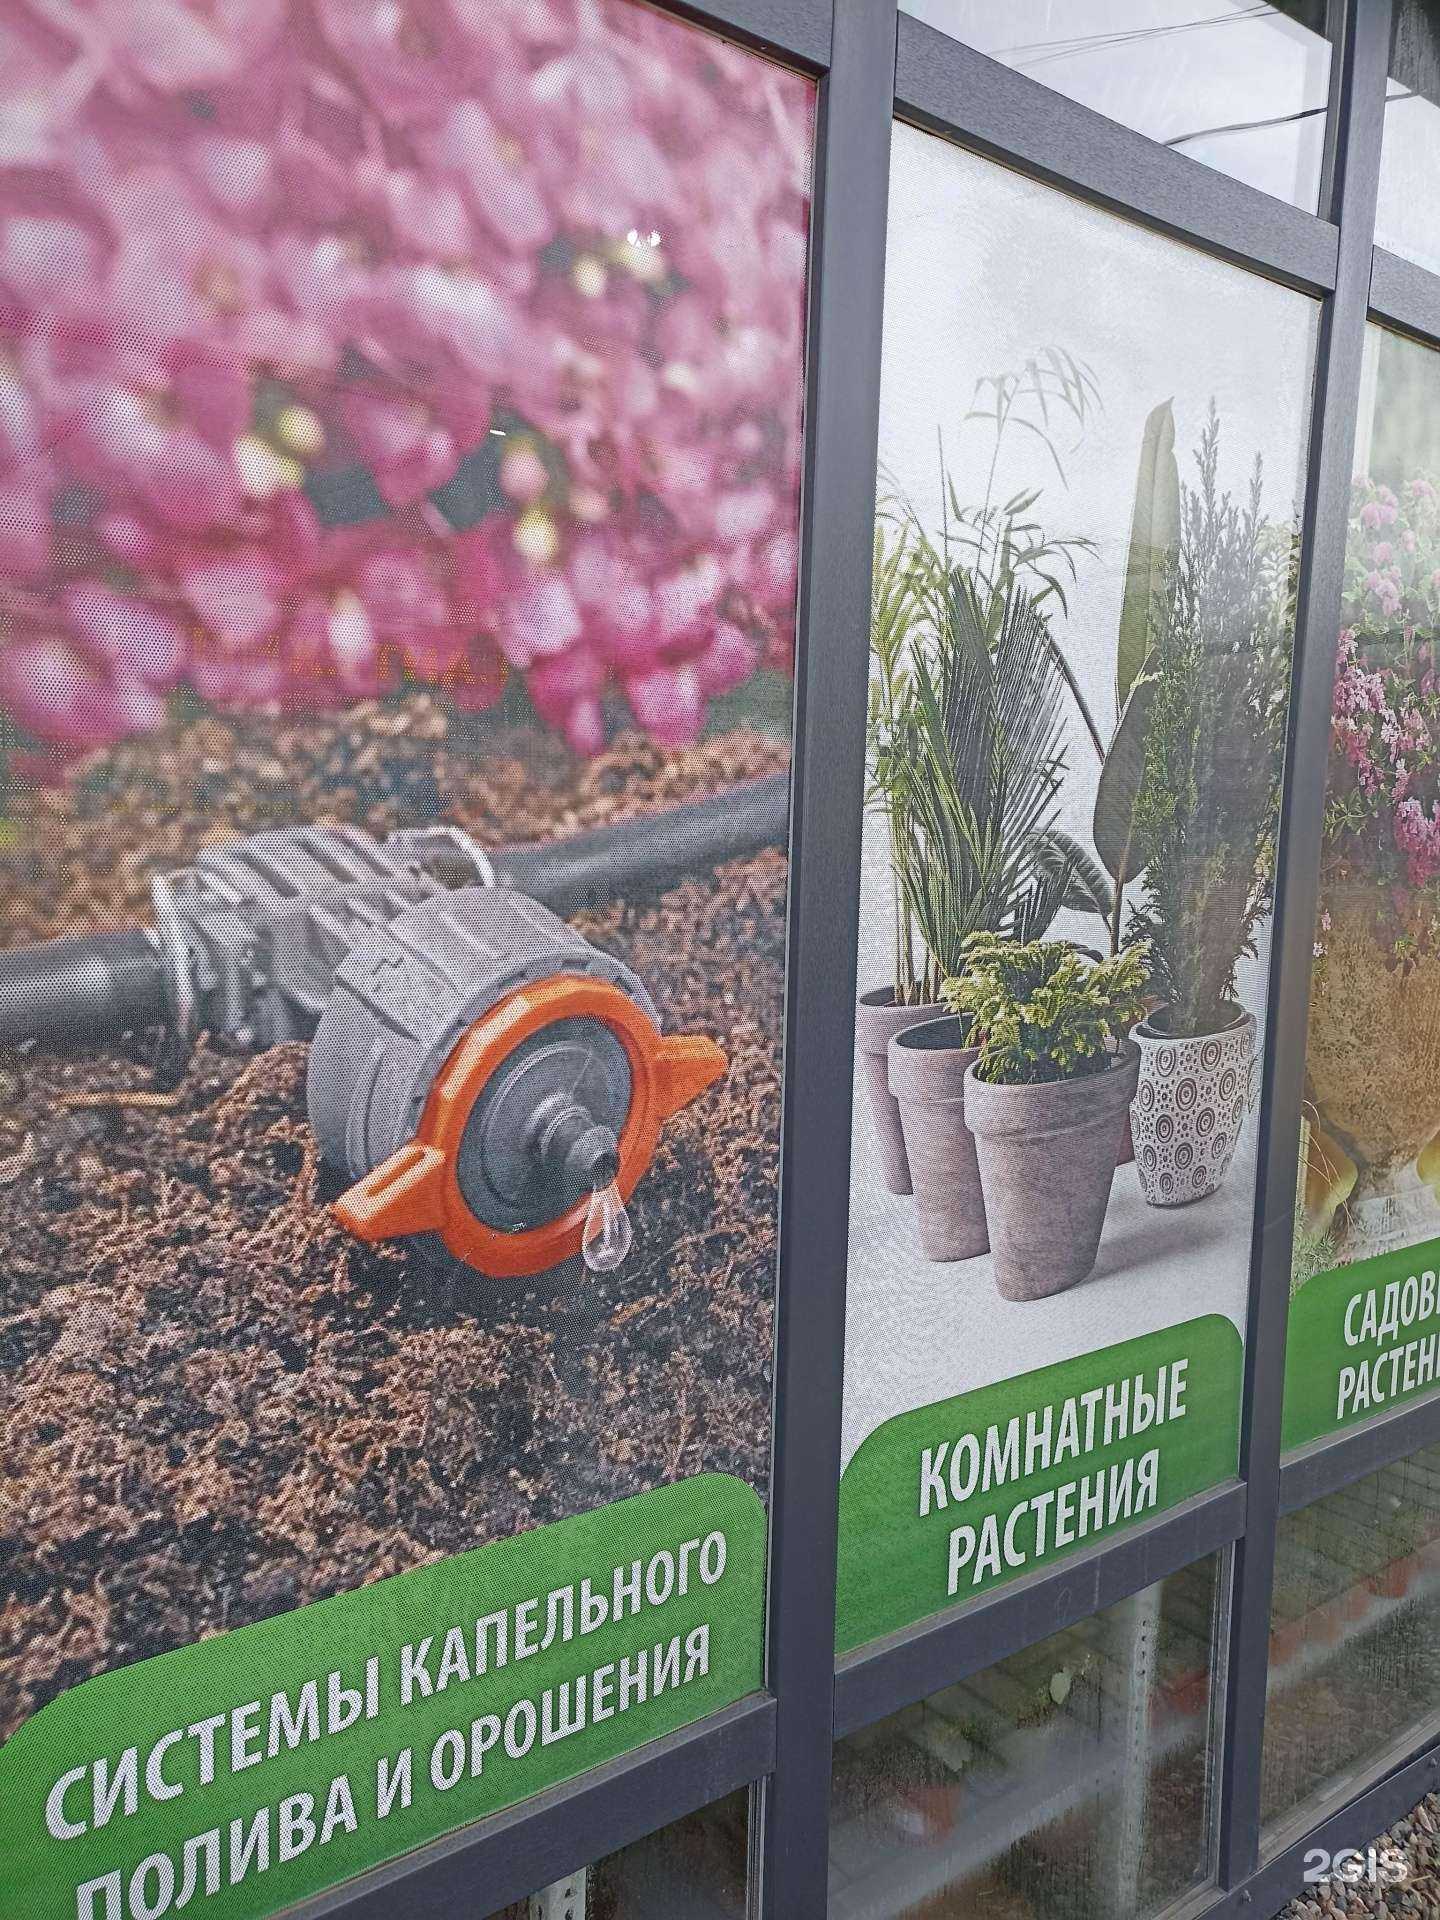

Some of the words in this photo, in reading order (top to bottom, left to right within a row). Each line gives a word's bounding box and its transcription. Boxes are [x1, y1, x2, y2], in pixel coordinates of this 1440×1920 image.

[1336, 1334, 1440, 1420] РАСТЕН
[1344, 1270, 1440, 1346] САДОВ
[920, 1359, 1189, 1517] КОМНАТНЫЕ
[947, 1449, 1160, 1595] РАСТЕНИЯ
[46, 1658, 380, 1840] СИСТЕМЫ
[401, 1531, 728, 1704] КАПЕЛЬНОГО
[76, 1774, 358, 1920] ПОЛИВА
[377, 1747, 412, 1820] И
[430, 1624, 711, 1791] ОРОШЕНИЯ
